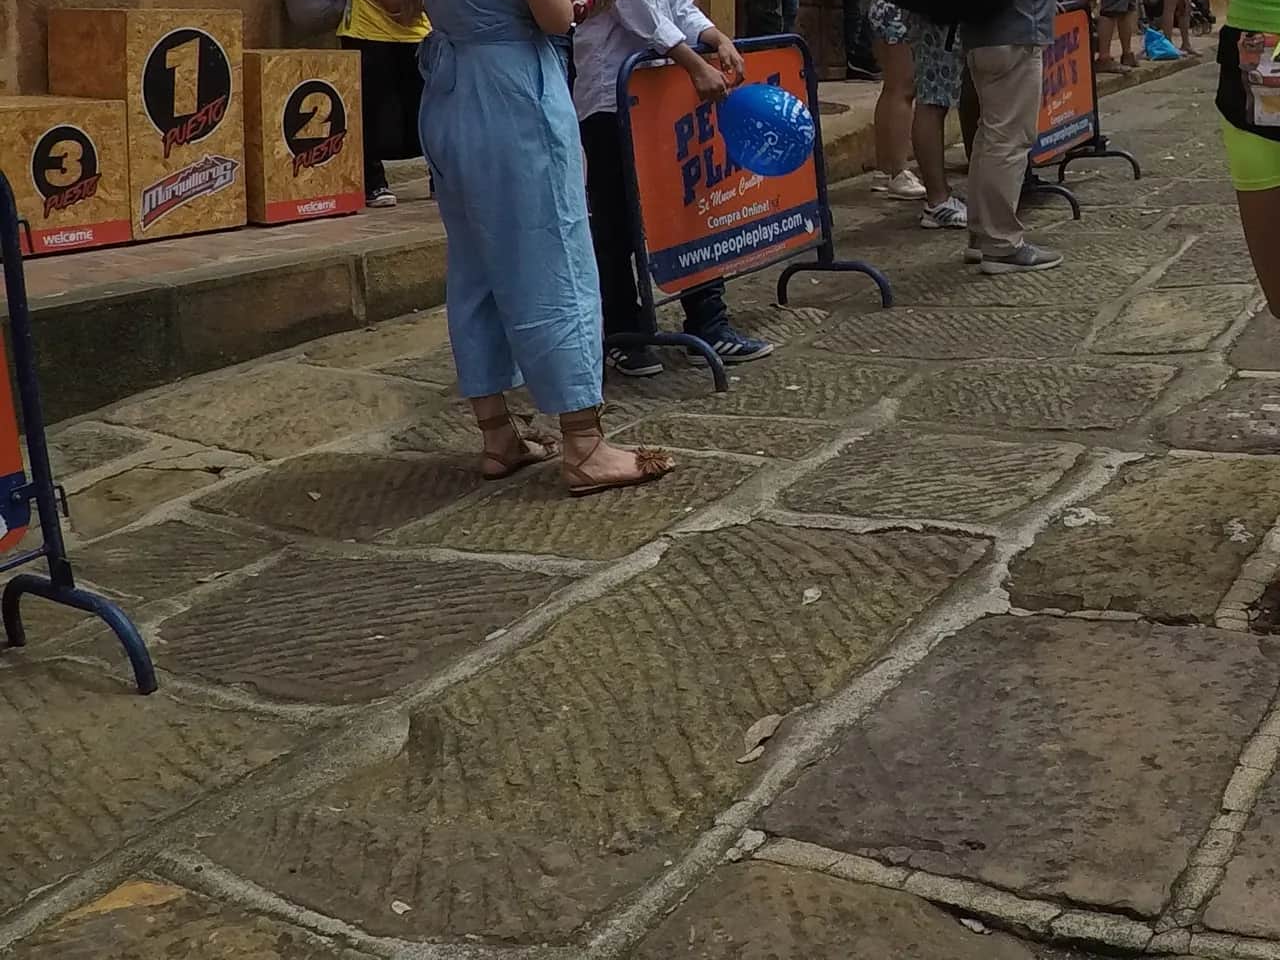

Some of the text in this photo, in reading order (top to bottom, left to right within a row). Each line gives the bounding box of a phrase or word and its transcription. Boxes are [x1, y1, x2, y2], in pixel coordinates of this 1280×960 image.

[166, 37, 200, 117] 1
[163, 95, 226, 159] PUESTO
[294, 92, 332, 139] 2
[44, 139, 83, 187] 3
[292, 130, 347, 178] PUESTO
[44, 173, 101, 219] PUESTO
[43, 231, 93, 247] welcome
[679, 213, 802, 268] www.peopleplays.com
[707, 212, 741, 229] Compra
